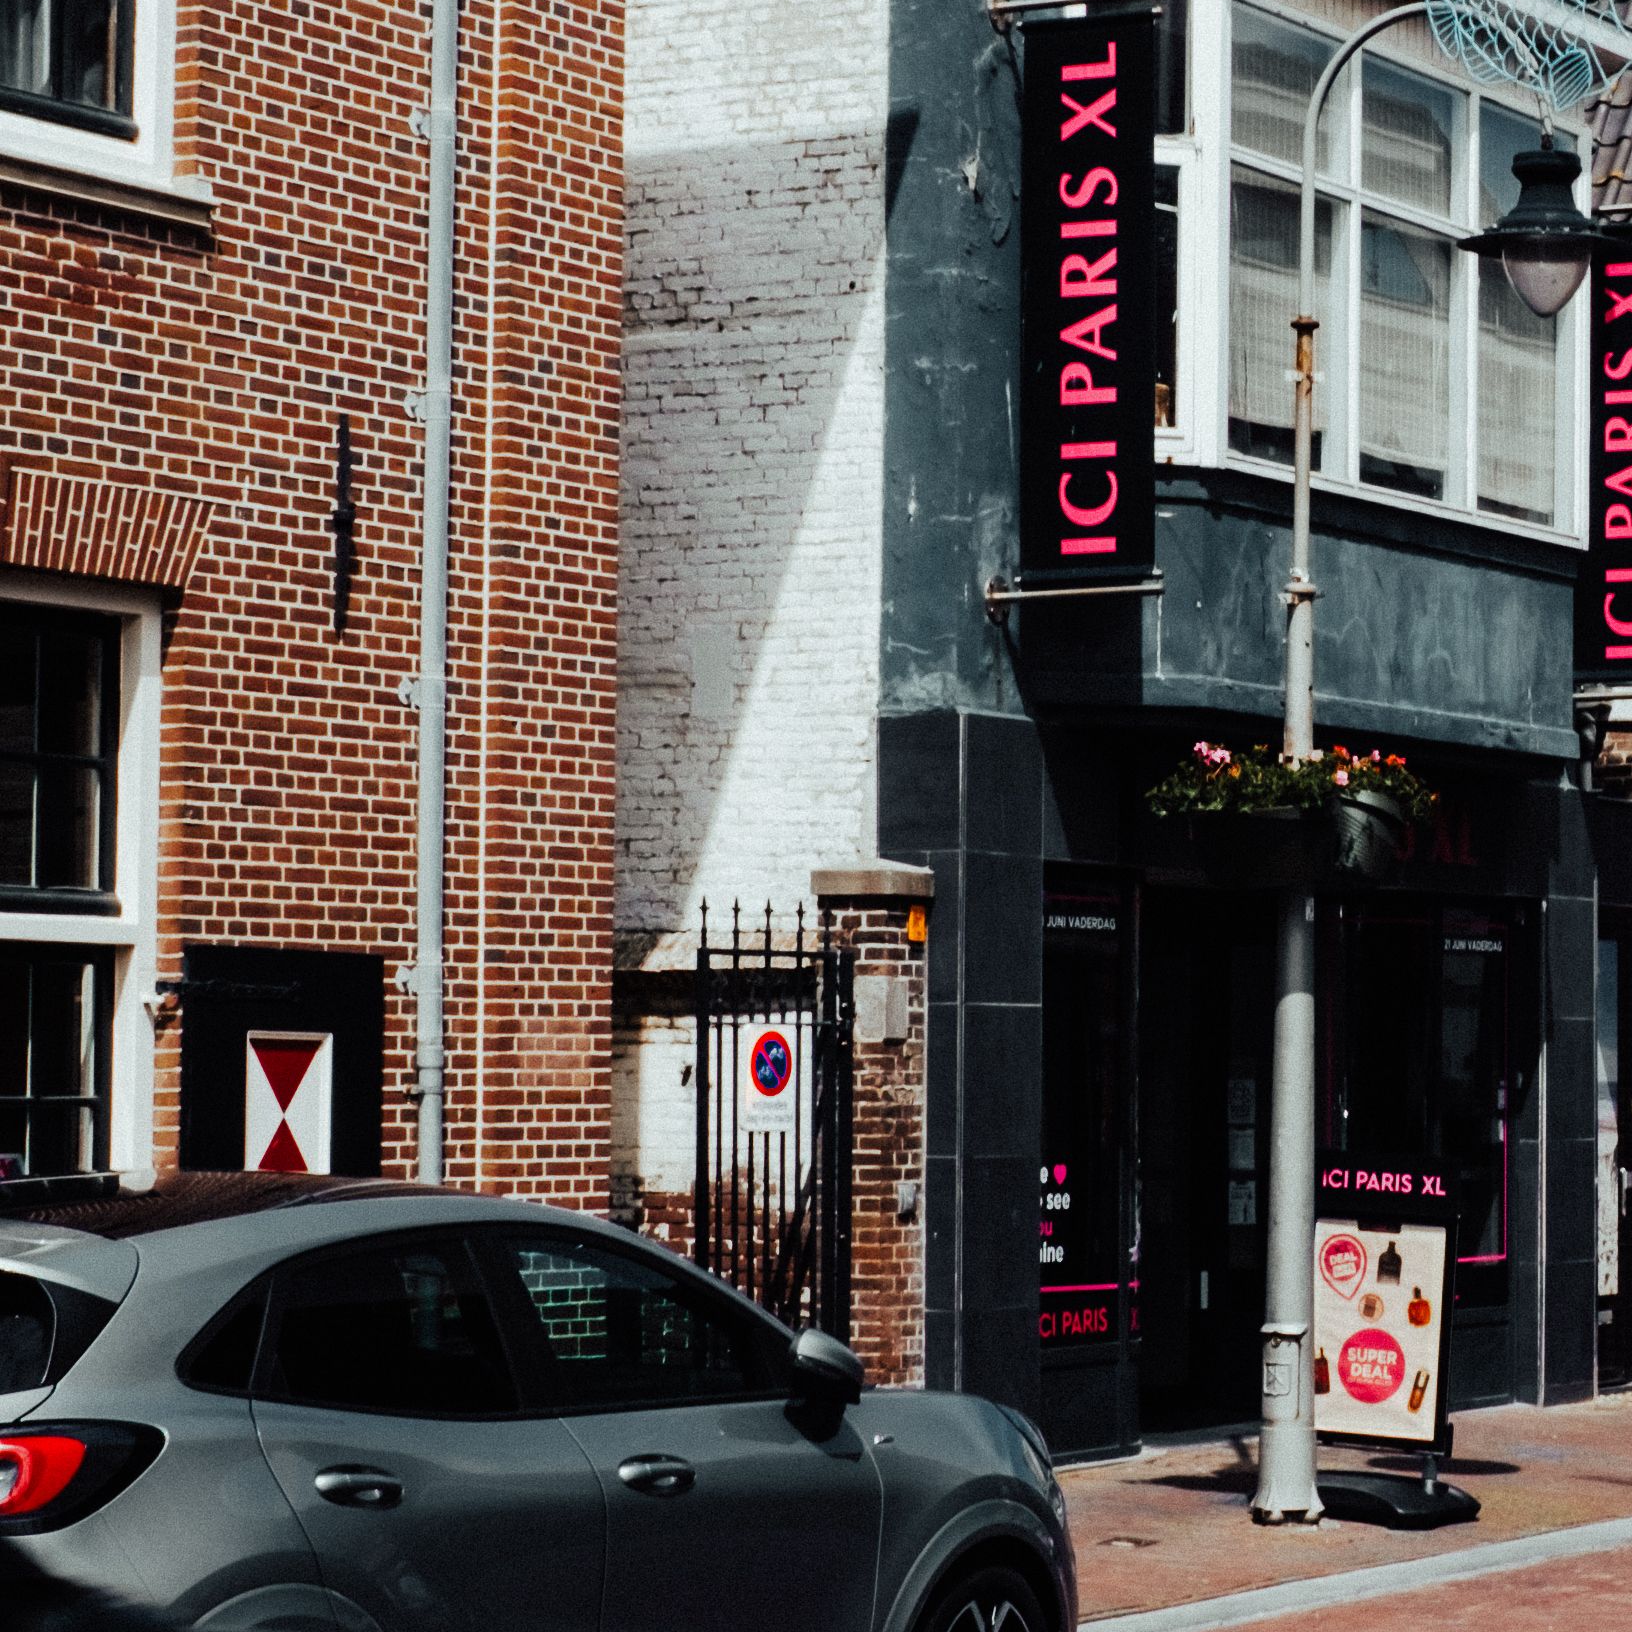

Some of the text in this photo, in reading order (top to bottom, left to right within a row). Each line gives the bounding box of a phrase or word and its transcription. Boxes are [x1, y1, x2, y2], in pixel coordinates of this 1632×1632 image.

[1058, 41, 1119, 555] ICI PARIS XL
[1046, 915, 1116, 931] JUNI VADERDAG
[1322, 1168, 1447, 1196] ICI PARIS XL
[1040, 1312, 1057, 1339] CI
[1062, 1306, 1109, 1336] PARIS
[1347, 1346, 1398, 1365] SUPER
[1350, 1362, 1393, 1380] DEAL
